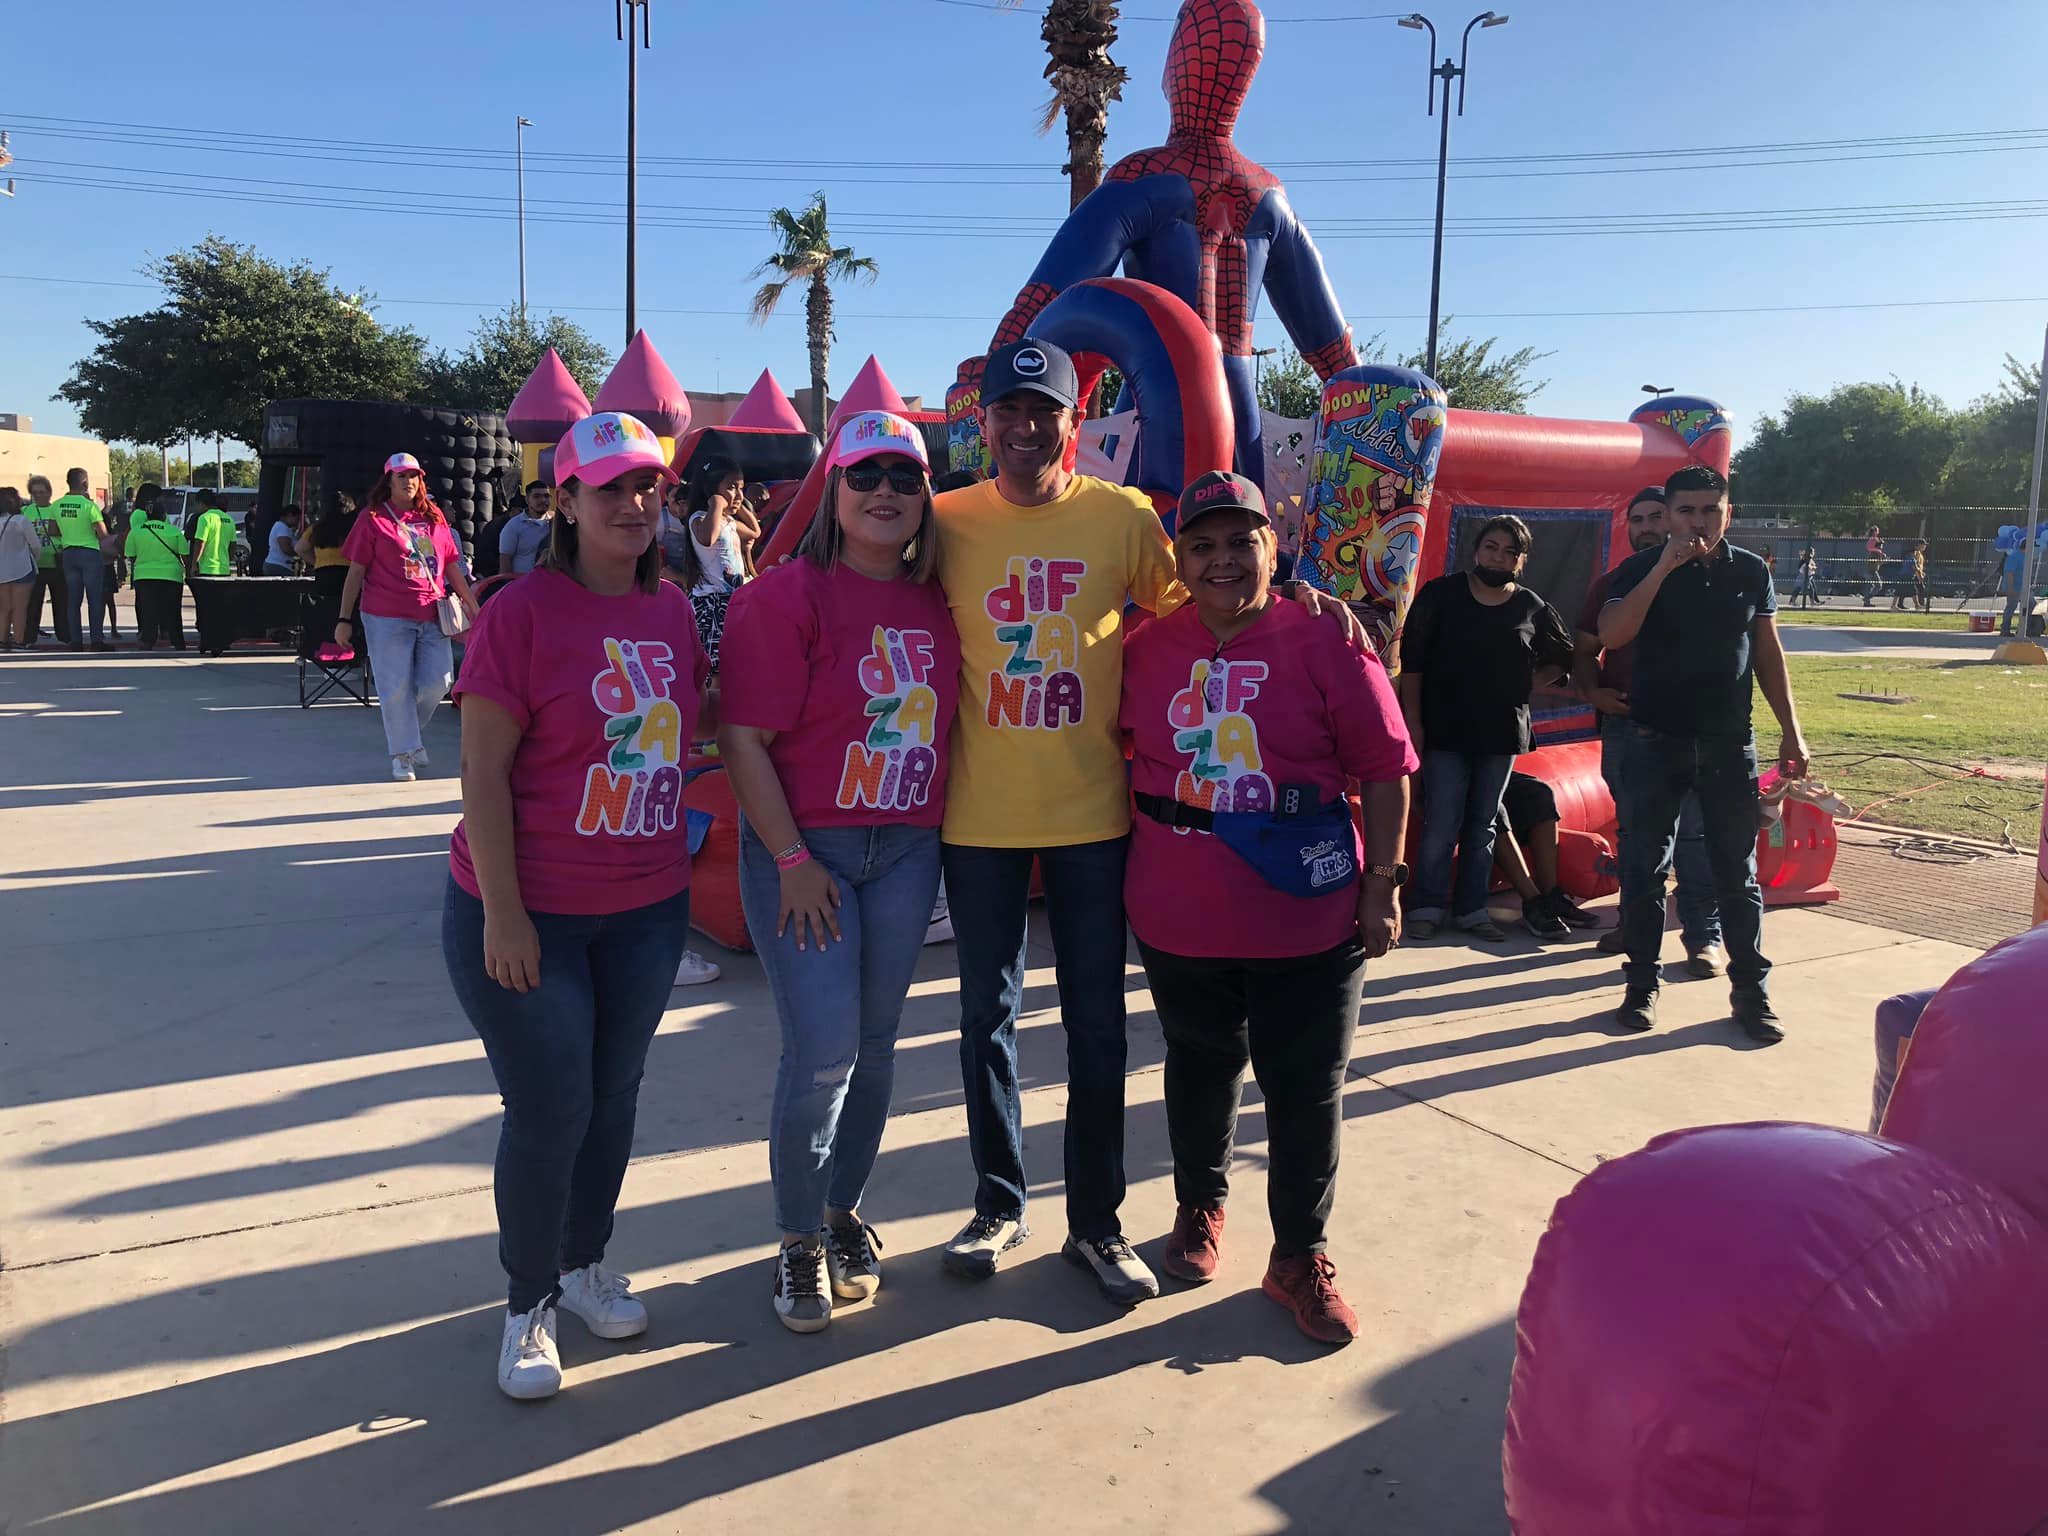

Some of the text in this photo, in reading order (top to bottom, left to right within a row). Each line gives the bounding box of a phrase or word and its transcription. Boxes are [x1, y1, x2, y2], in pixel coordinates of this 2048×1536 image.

[994, 614, 1077, 676] ZA
[604, 700, 680, 770] ZA
[865, 686, 937, 748] ZA
[1174, 713, 1263, 778] ZA
